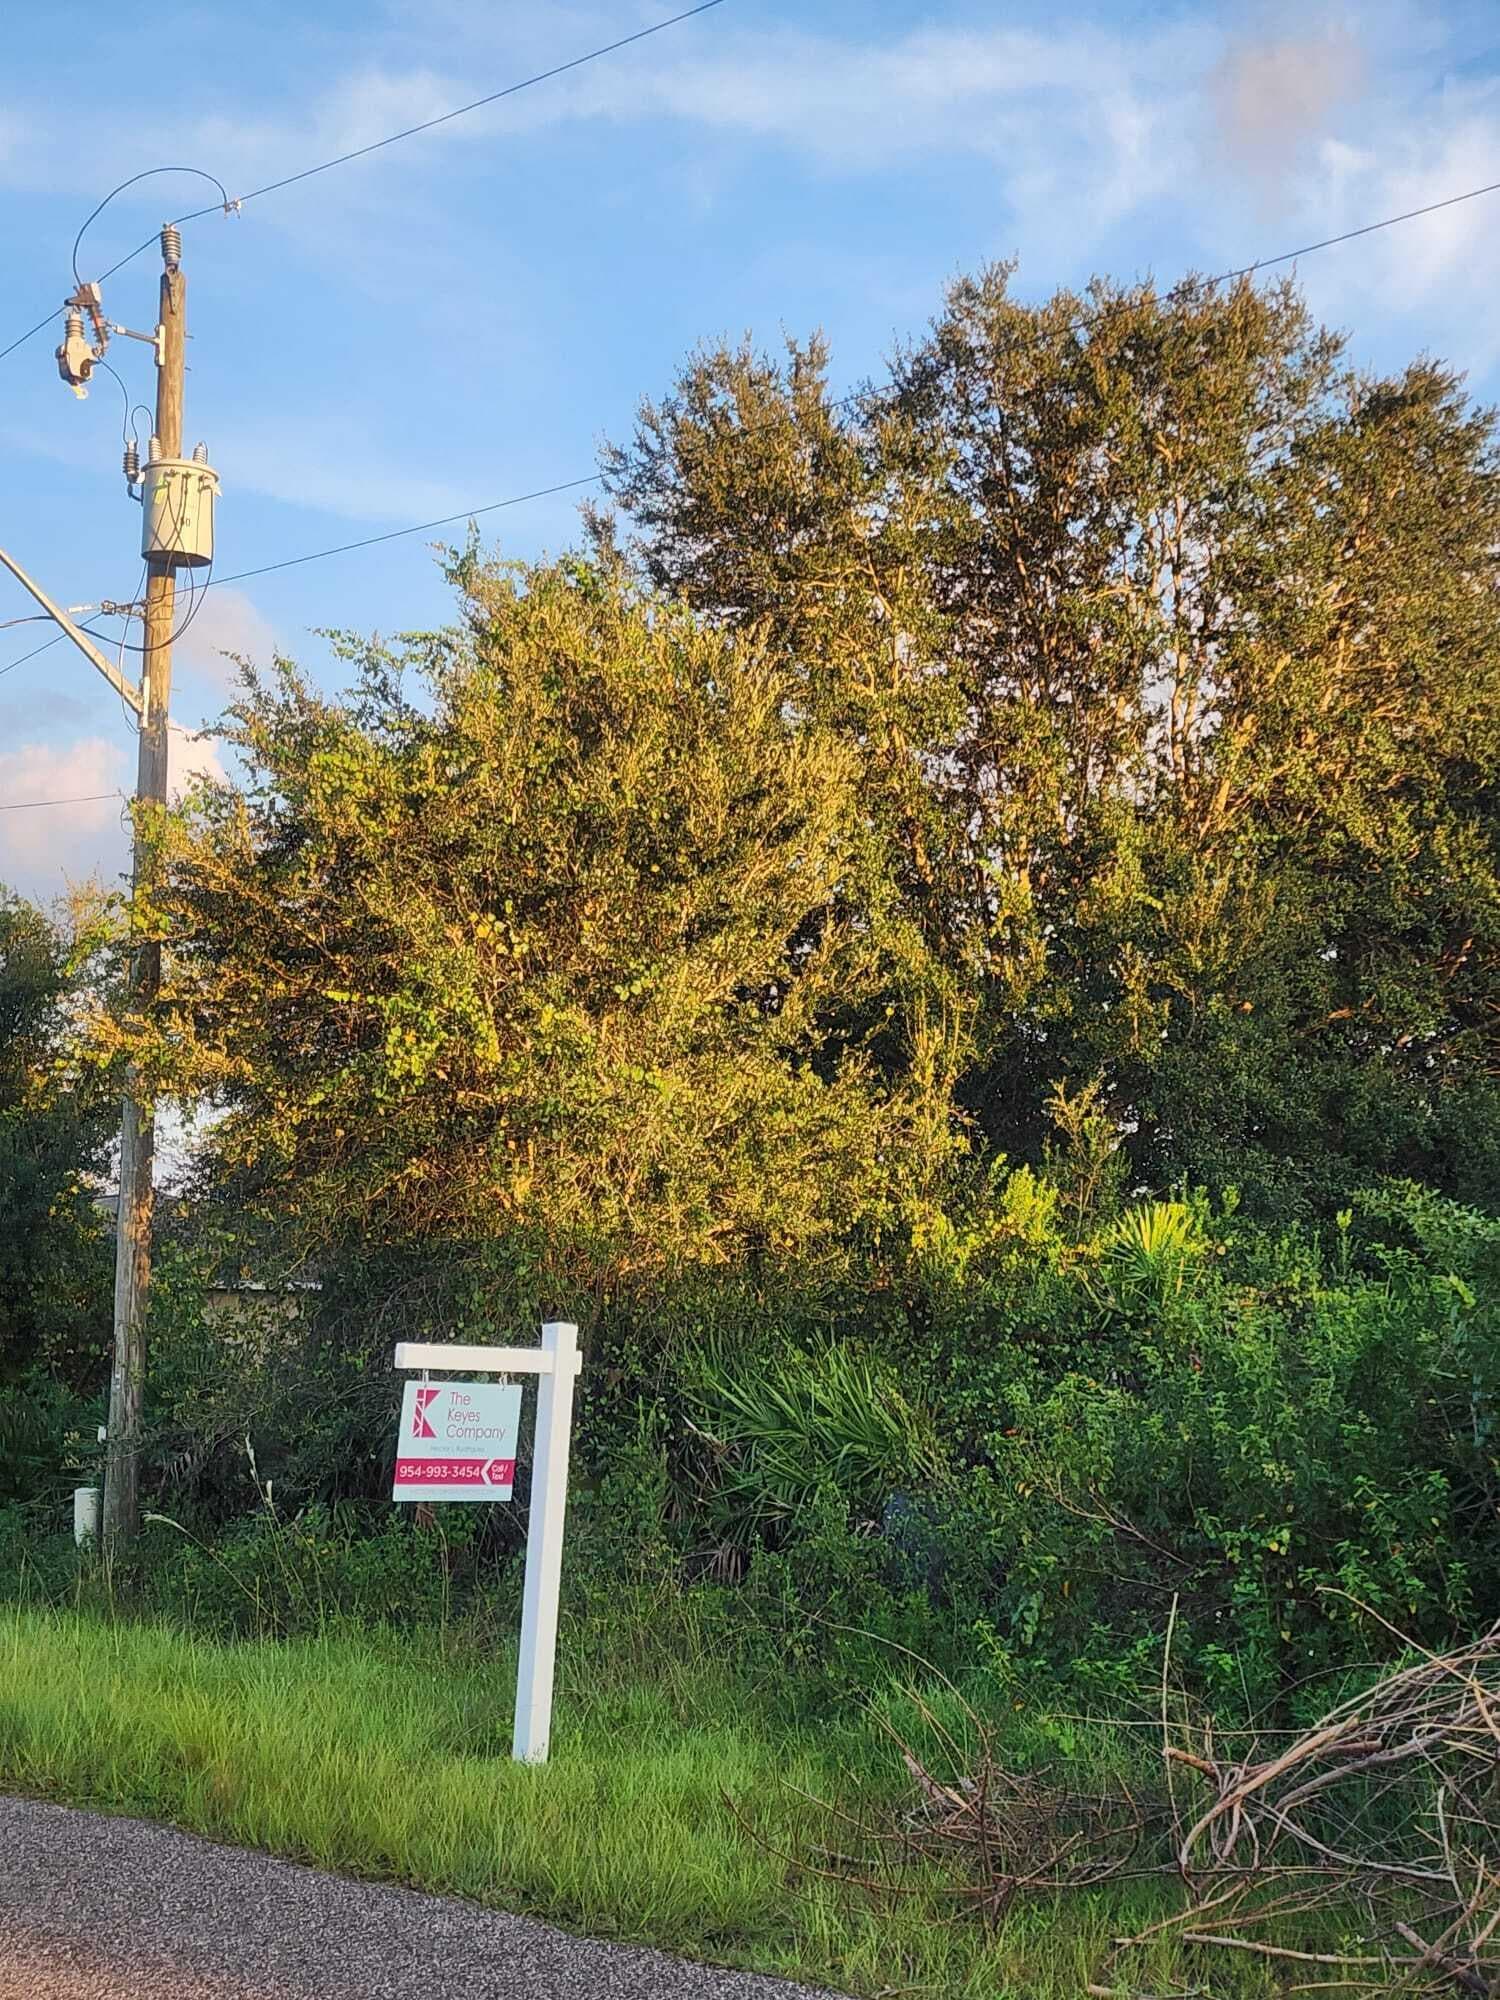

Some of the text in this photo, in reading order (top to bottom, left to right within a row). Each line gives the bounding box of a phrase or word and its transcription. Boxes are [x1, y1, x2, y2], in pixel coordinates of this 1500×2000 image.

[450, 1391, 471, 1406] The
[447, 1407, 480, 1425] Keyes
[446, 1424, 506, 1441] Company
[399, 1465, 480, 1478] 954-993-3454
